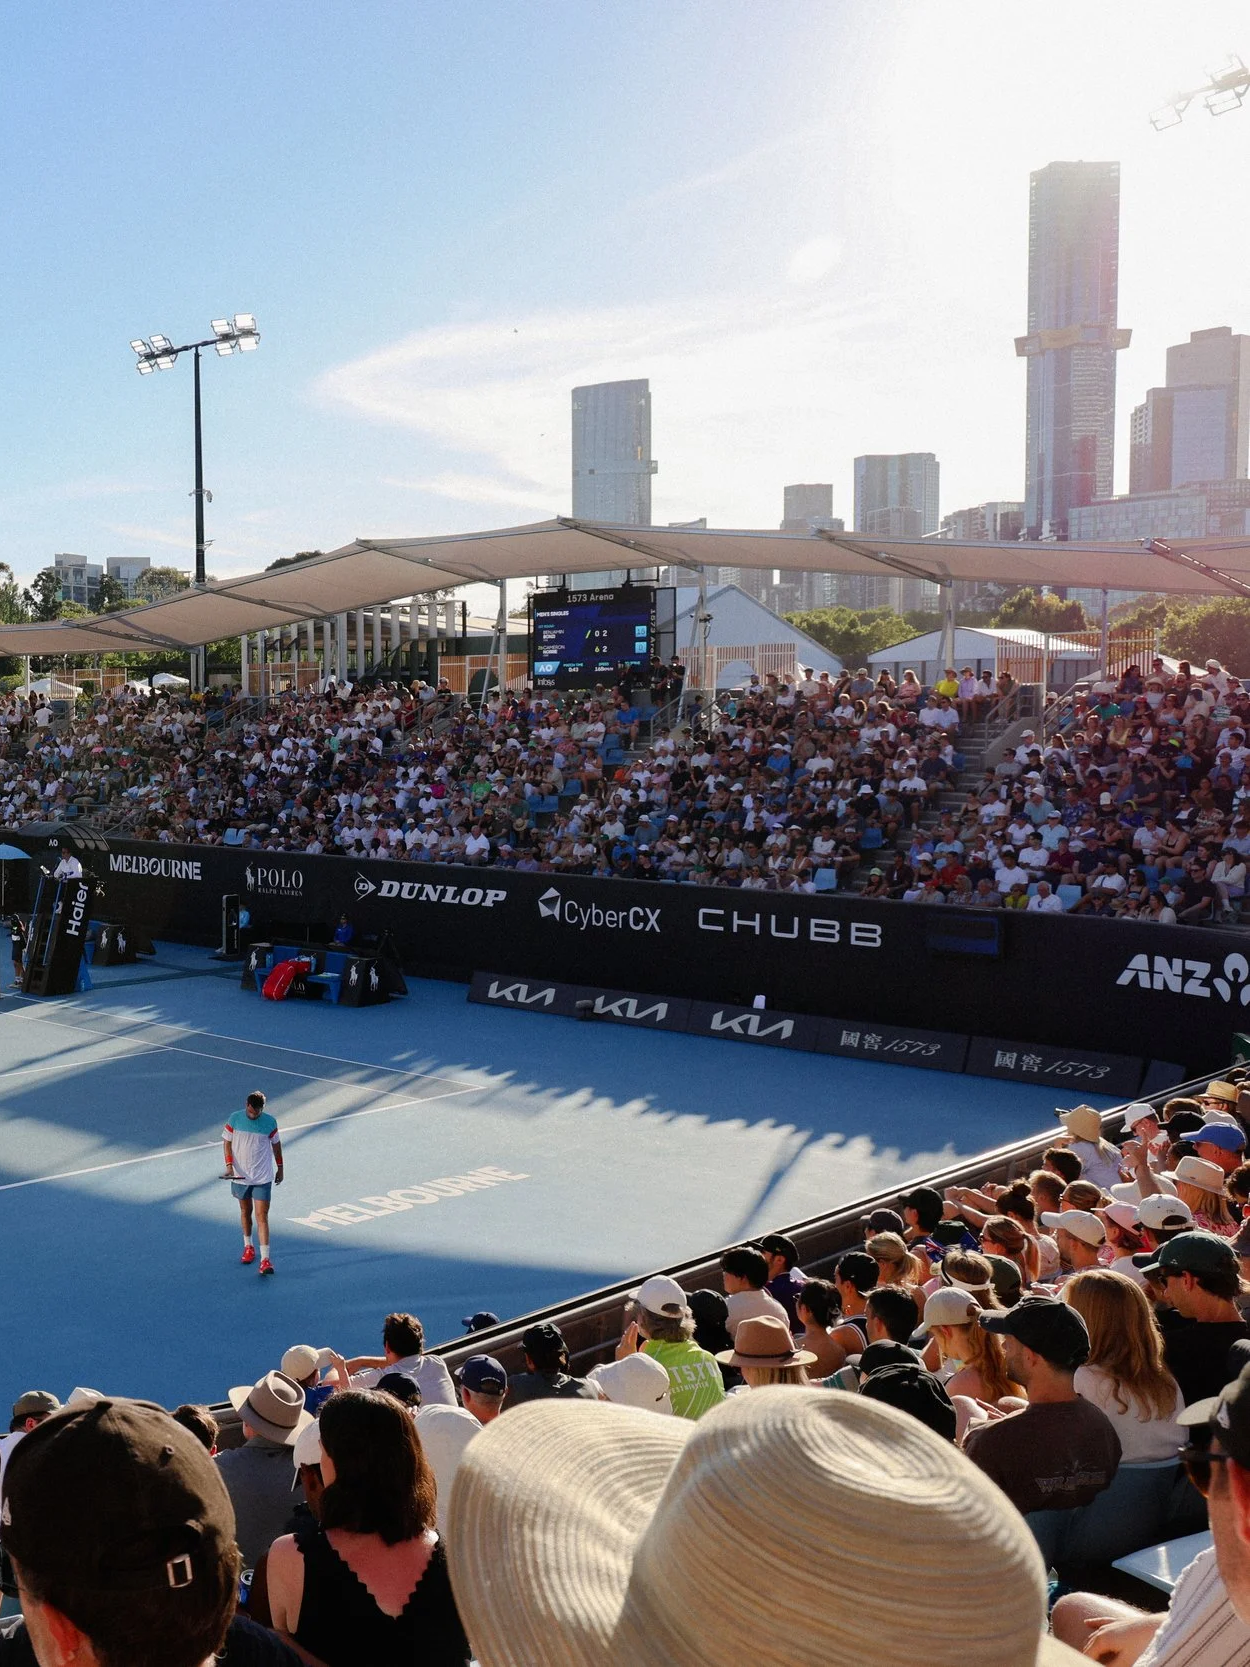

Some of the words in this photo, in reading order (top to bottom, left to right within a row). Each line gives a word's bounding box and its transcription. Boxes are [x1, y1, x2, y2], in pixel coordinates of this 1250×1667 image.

[567, 594, 588, 603] 1573
[590, 593, 614, 602] Arena
[595, 645, 600, 653] 6
[602, 645, 608, 653] 2
[538, 663, 553, 673] AO
[537, 677, 555, 687] Infosys
[110, 853, 202, 881] MELBOURNE
[257, 867, 303, 889] POLO
[257, 887, 277, 895] RALPH
[280, 889, 303, 897] LAUREN
[377, 880, 507, 907] DUNLOP
[66, 882, 89, 937] Haier
[564, 900, 661, 932] CyberCX
[698, 907, 882, 948] CHUBB
[1116, 953, 1212, 998] ANZ
[487, 980, 556, 1006] KIA
[593, 995, 669, 1022] KIA
[711, 1010, 795, 1040] KIA
[285, 1165, 531, 1232] MELBOURNE
